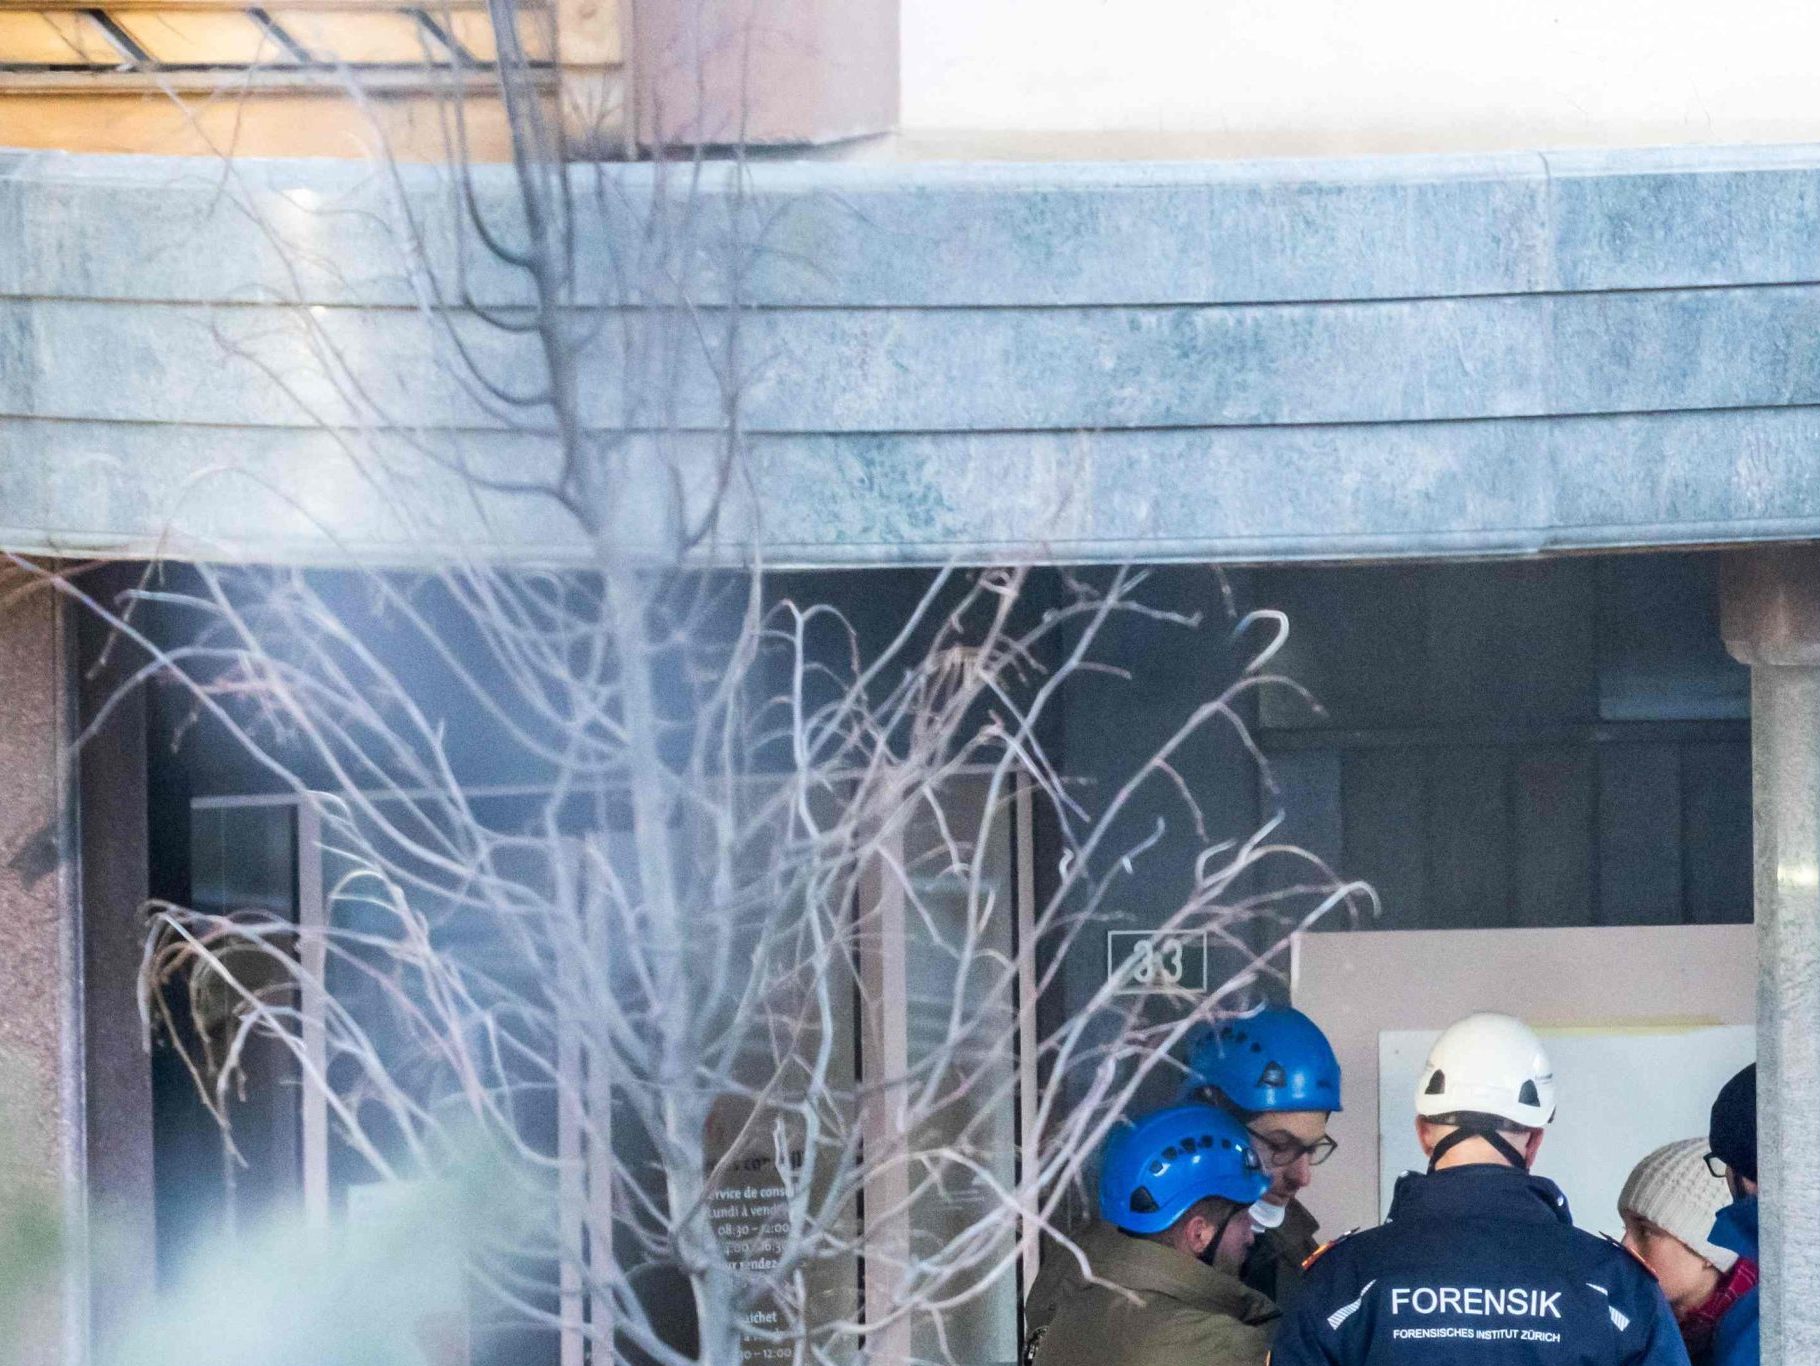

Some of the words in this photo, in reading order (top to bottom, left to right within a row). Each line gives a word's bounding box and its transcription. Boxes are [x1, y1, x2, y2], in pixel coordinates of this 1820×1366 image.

[744, 1186, 758, 1199] de
[1391, 1287, 1562, 1319] FORENSIK
[1393, 1327, 1474, 1339] FORENSISCHES
[1476, 1329, 1519, 1340] INSTITUT
[1520, 1329, 1561, 1343] ZÜRICH
